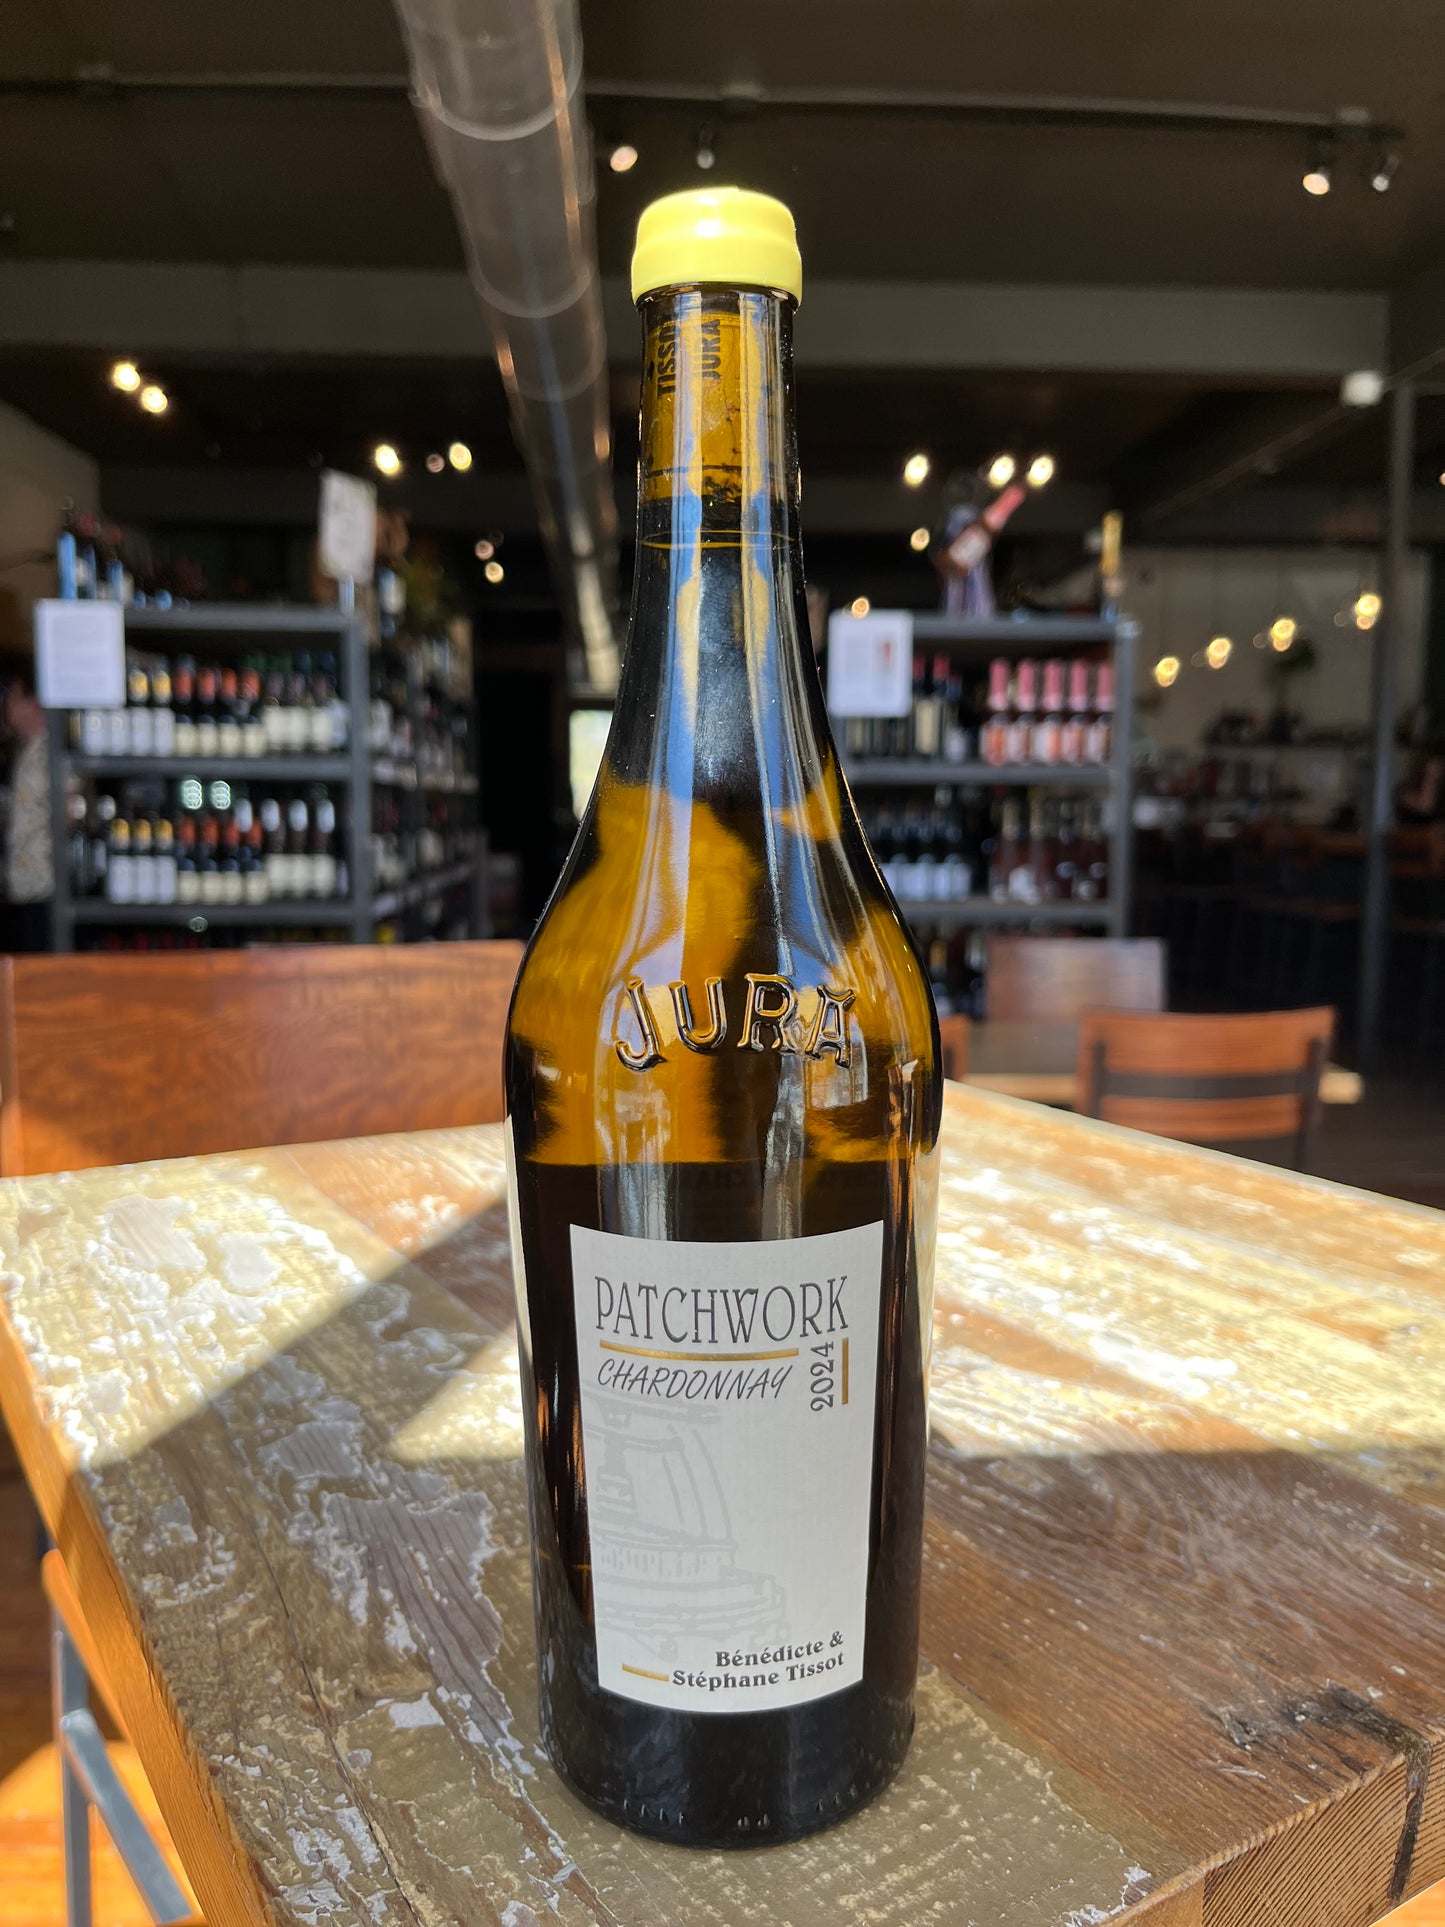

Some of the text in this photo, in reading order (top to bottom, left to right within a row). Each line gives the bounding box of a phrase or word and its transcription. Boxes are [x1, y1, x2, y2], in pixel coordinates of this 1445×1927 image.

[615, 972, 856, 1073] JURA
[594, 1275, 849, 1344] PATCHWORK
[597, 1358, 793, 1400] CHARDONNAY
[810, 1341, 834, 1412] 2024
[672, 1651, 844, 1692] Stéphane Tissot
[715, 1630, 844, 1668] Bénédicte &
